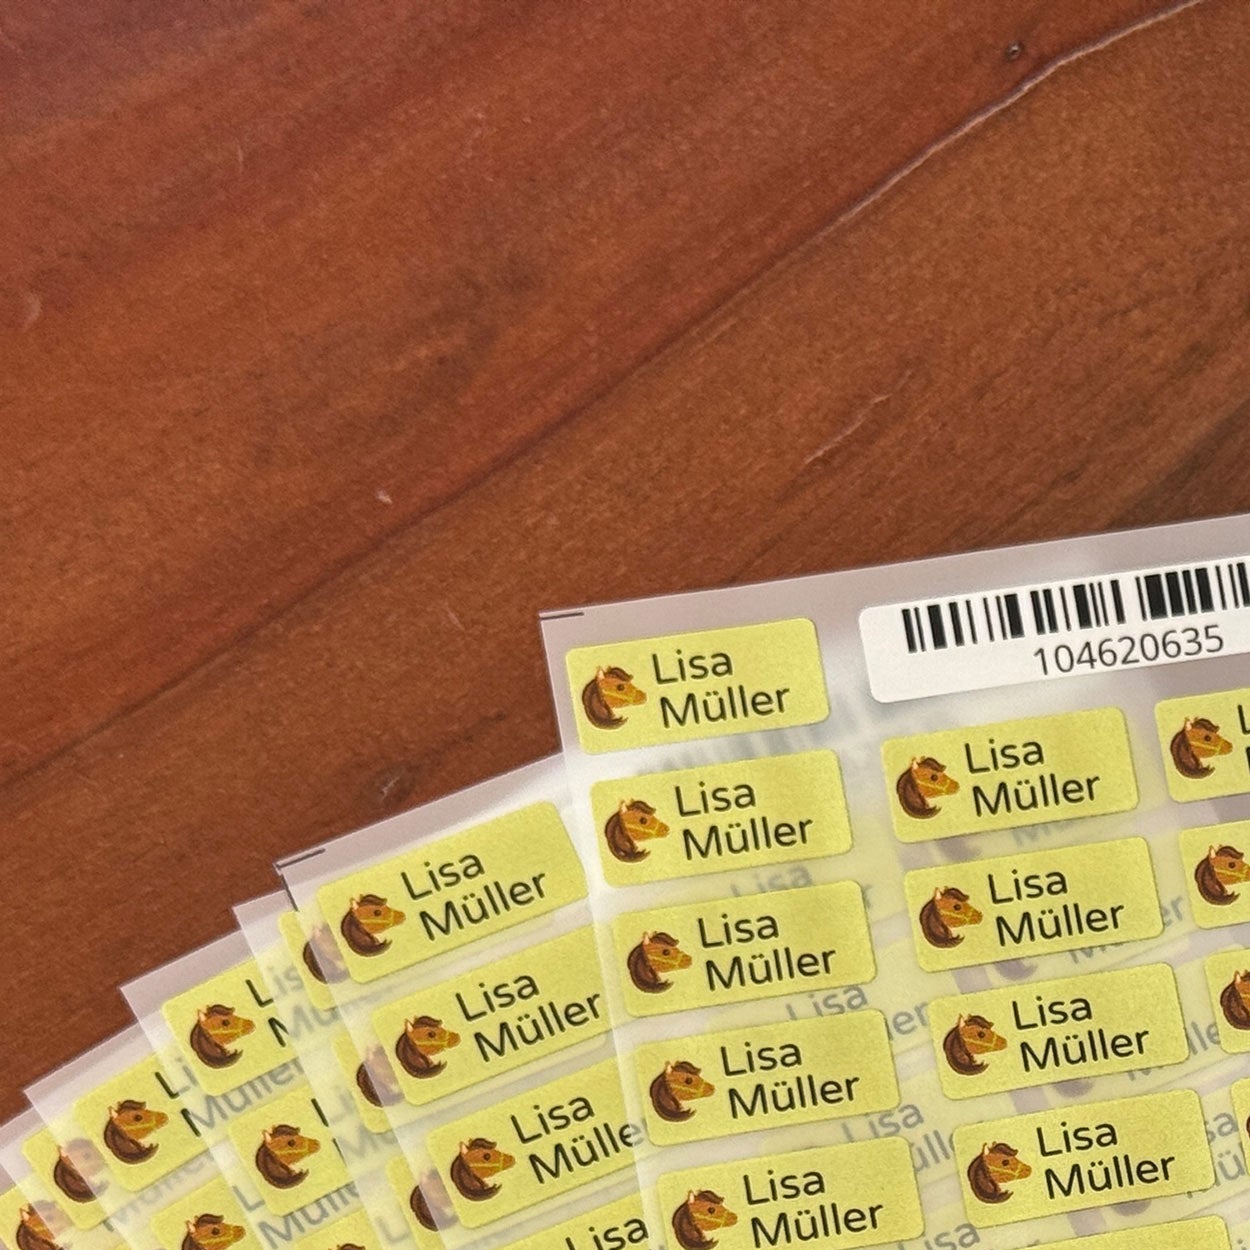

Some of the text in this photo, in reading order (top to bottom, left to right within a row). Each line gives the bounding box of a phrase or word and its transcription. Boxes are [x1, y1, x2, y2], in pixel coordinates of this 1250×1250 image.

[651, 648, 733, 685] Lisa
[1034, 624, 1225, 676] 104620635
[659, 684, 790, 729] Müller
[964, 738, 1045, 774] Lisa
[674, 781, 756, 818] Lisa
[972, 772, 1101, 818] Müller
[682, 816, 813, 861] Müller
[400, 854, 485, 901] Lisa
[987, 868, 1068, 905] Lisa
[418, 873, 547, 941] Müller
[995, 902, 1125, 947] Müller
[697, 913, 780, 949] Lisa
[705, 946, 836, 992] Müller
[455, 975, 540, 1022] Lisa
[1012, 995, 1093, 1031] Lisa
[473, 992, 601, 1063] Müller
[720, 1041, 802, 1077] Lisa
[1019, 1028, 1150, 1073] Müller
[727, 1074, 860, 1119] Müller
[510, 1096, 595, 1145] Lisa
[1036, 1121, 1118, 1158] Lisa
[528, 1121, 646, 1184] Mülle
[742, 1169, 826, 1206] Lisa
[1044, 1153, 1176, 1200] Müller
[750, 1202, 884, 1249] Müller
